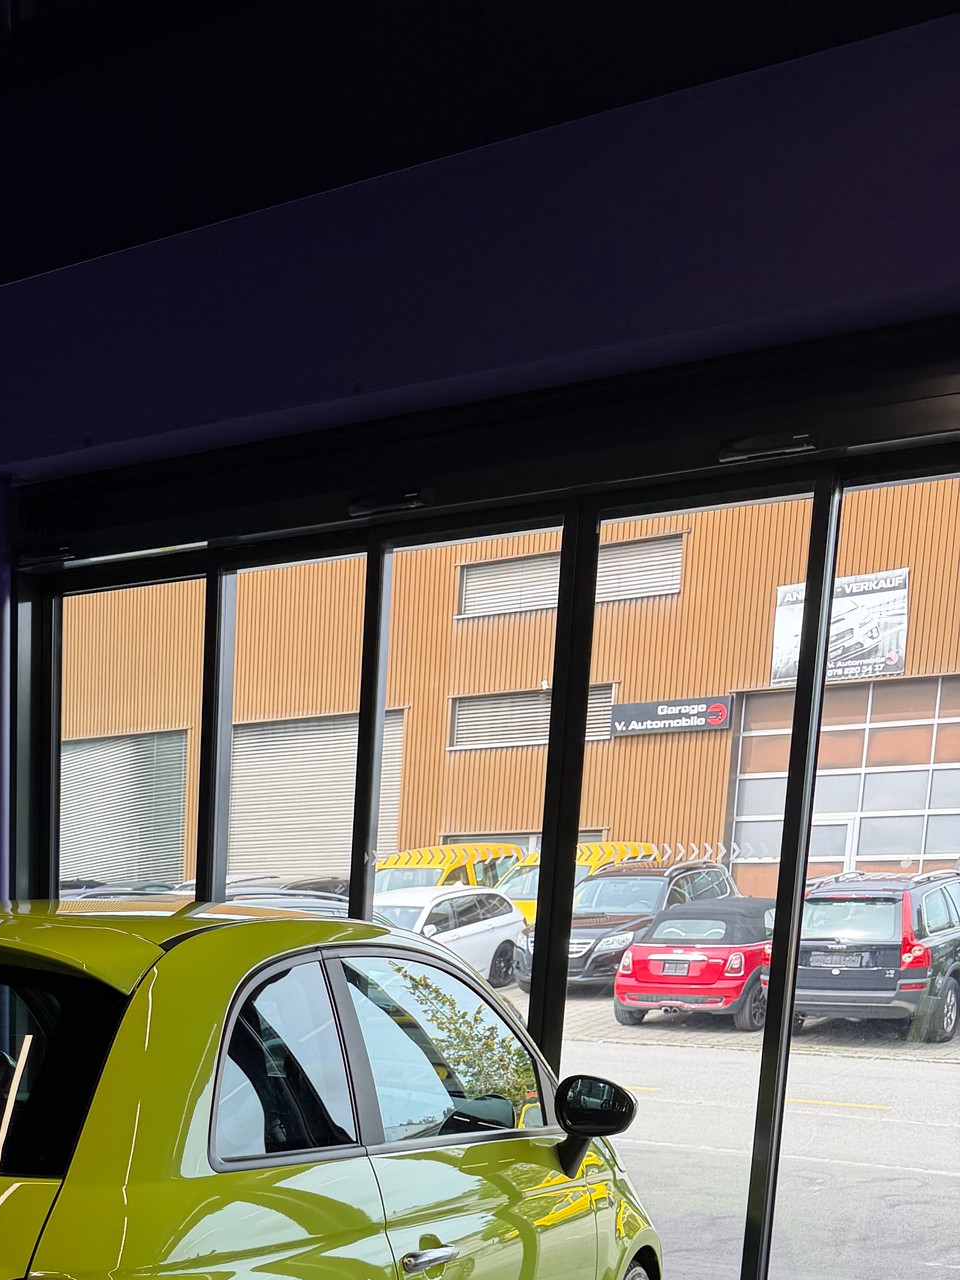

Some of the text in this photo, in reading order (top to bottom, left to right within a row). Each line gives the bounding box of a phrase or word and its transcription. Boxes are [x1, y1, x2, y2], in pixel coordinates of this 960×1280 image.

[843, 576, 904, 594] VERKAUF
[657, 703, 707, 716] Garage
[614, 716, 706, 731] V. Automobile
